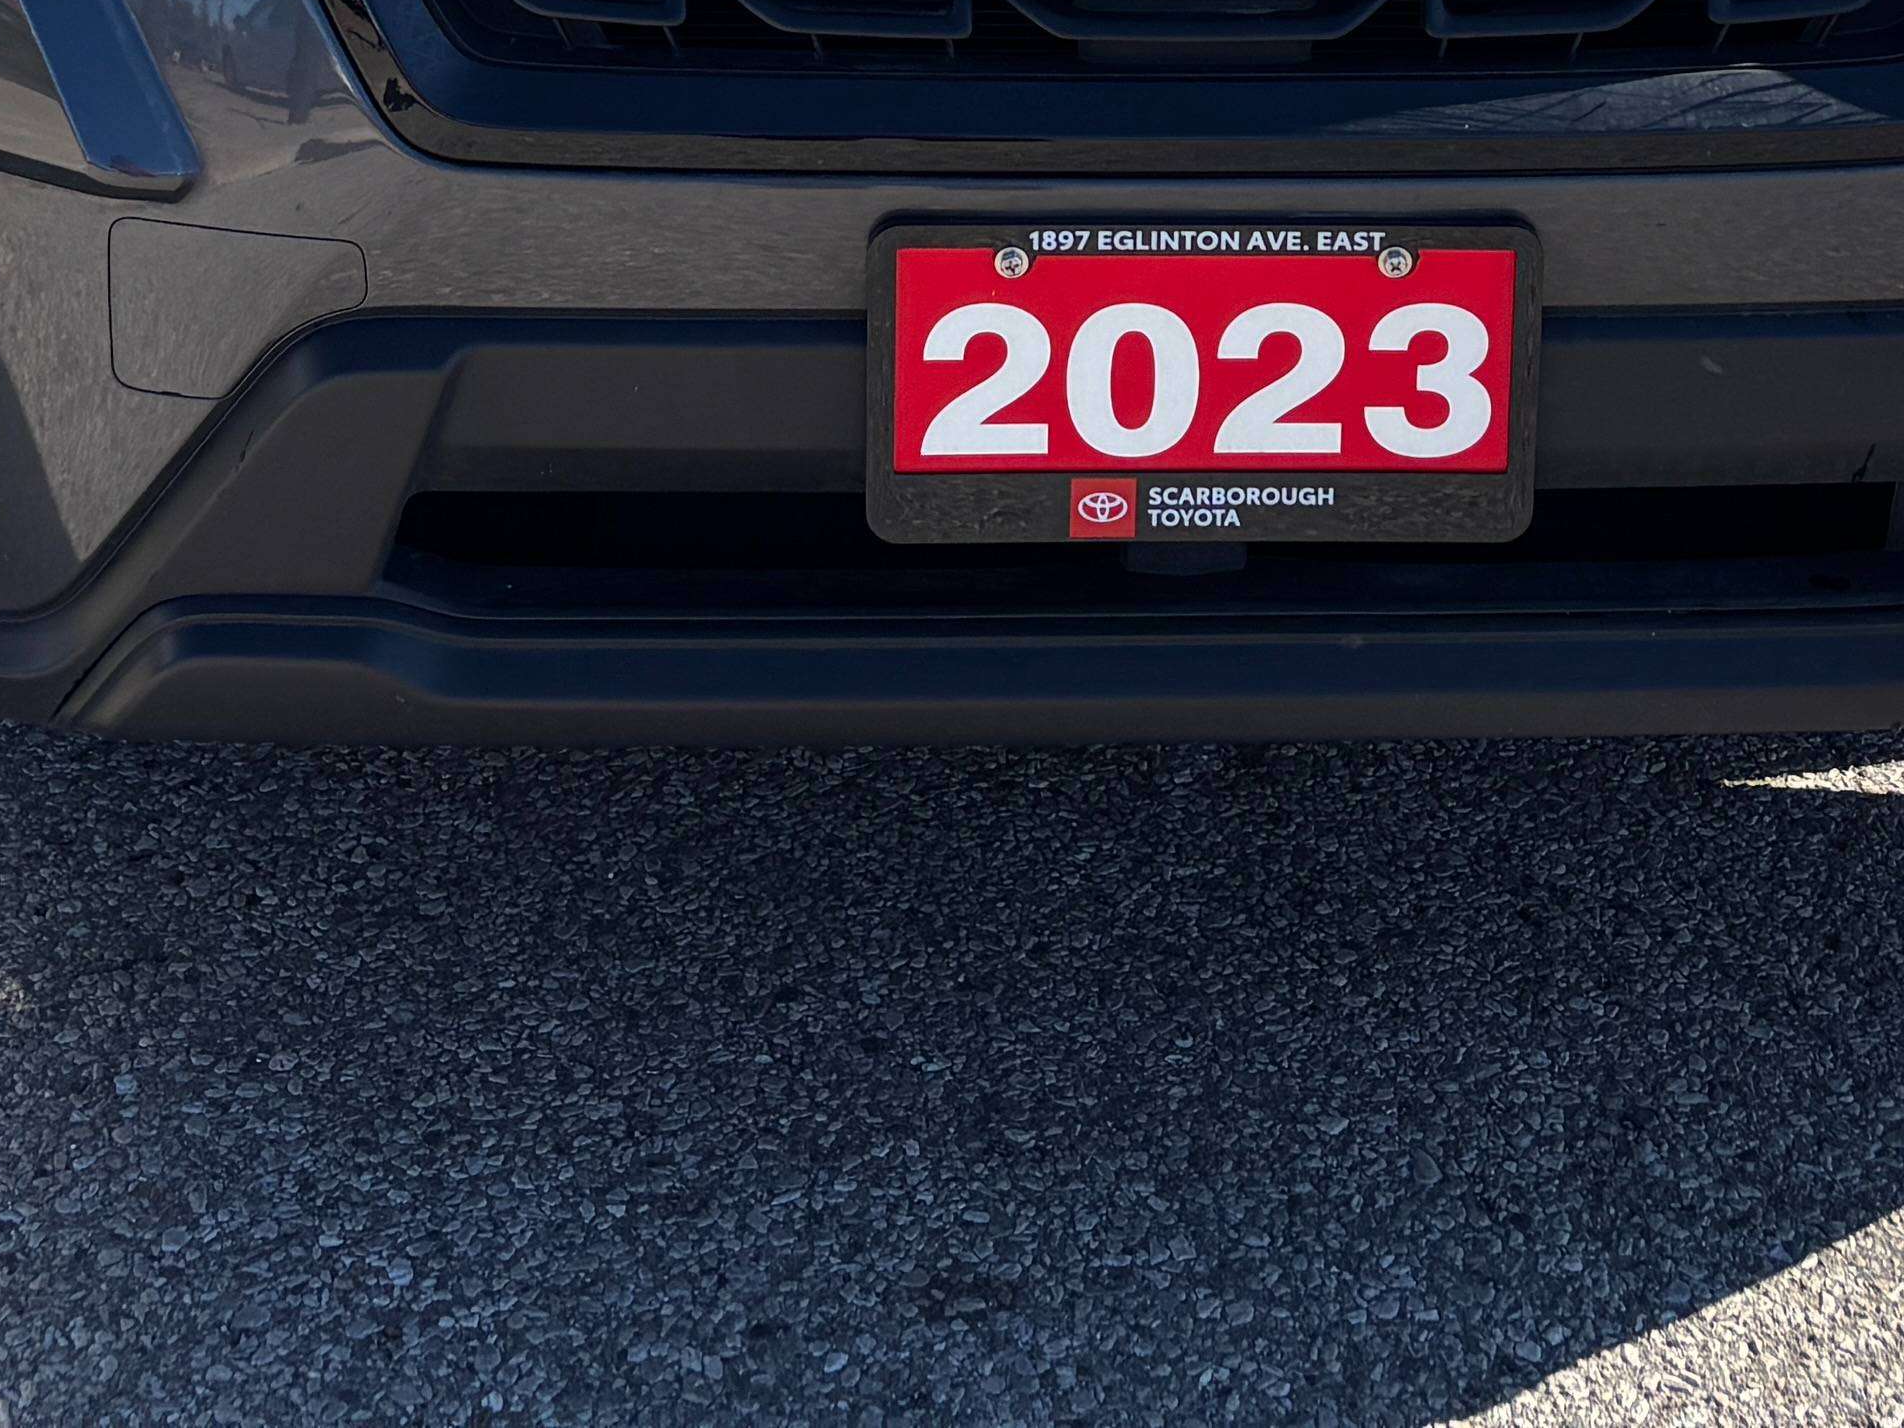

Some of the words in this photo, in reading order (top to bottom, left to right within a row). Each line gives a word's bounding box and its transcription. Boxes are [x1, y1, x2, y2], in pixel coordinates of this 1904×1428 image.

[1029, 230, 1091, 251] 1897
[1096, 230, 1244, 251] EGLINTON
[1246, 230, 1309, 251] AVE.
[1317, 230, 1386, 252] EAST
[920, 302, 1493, 458] 2023
[1148, 486, 1335, 506] SCARBOROUGH
[1147, 508, 1241, 528] TOYOTA
